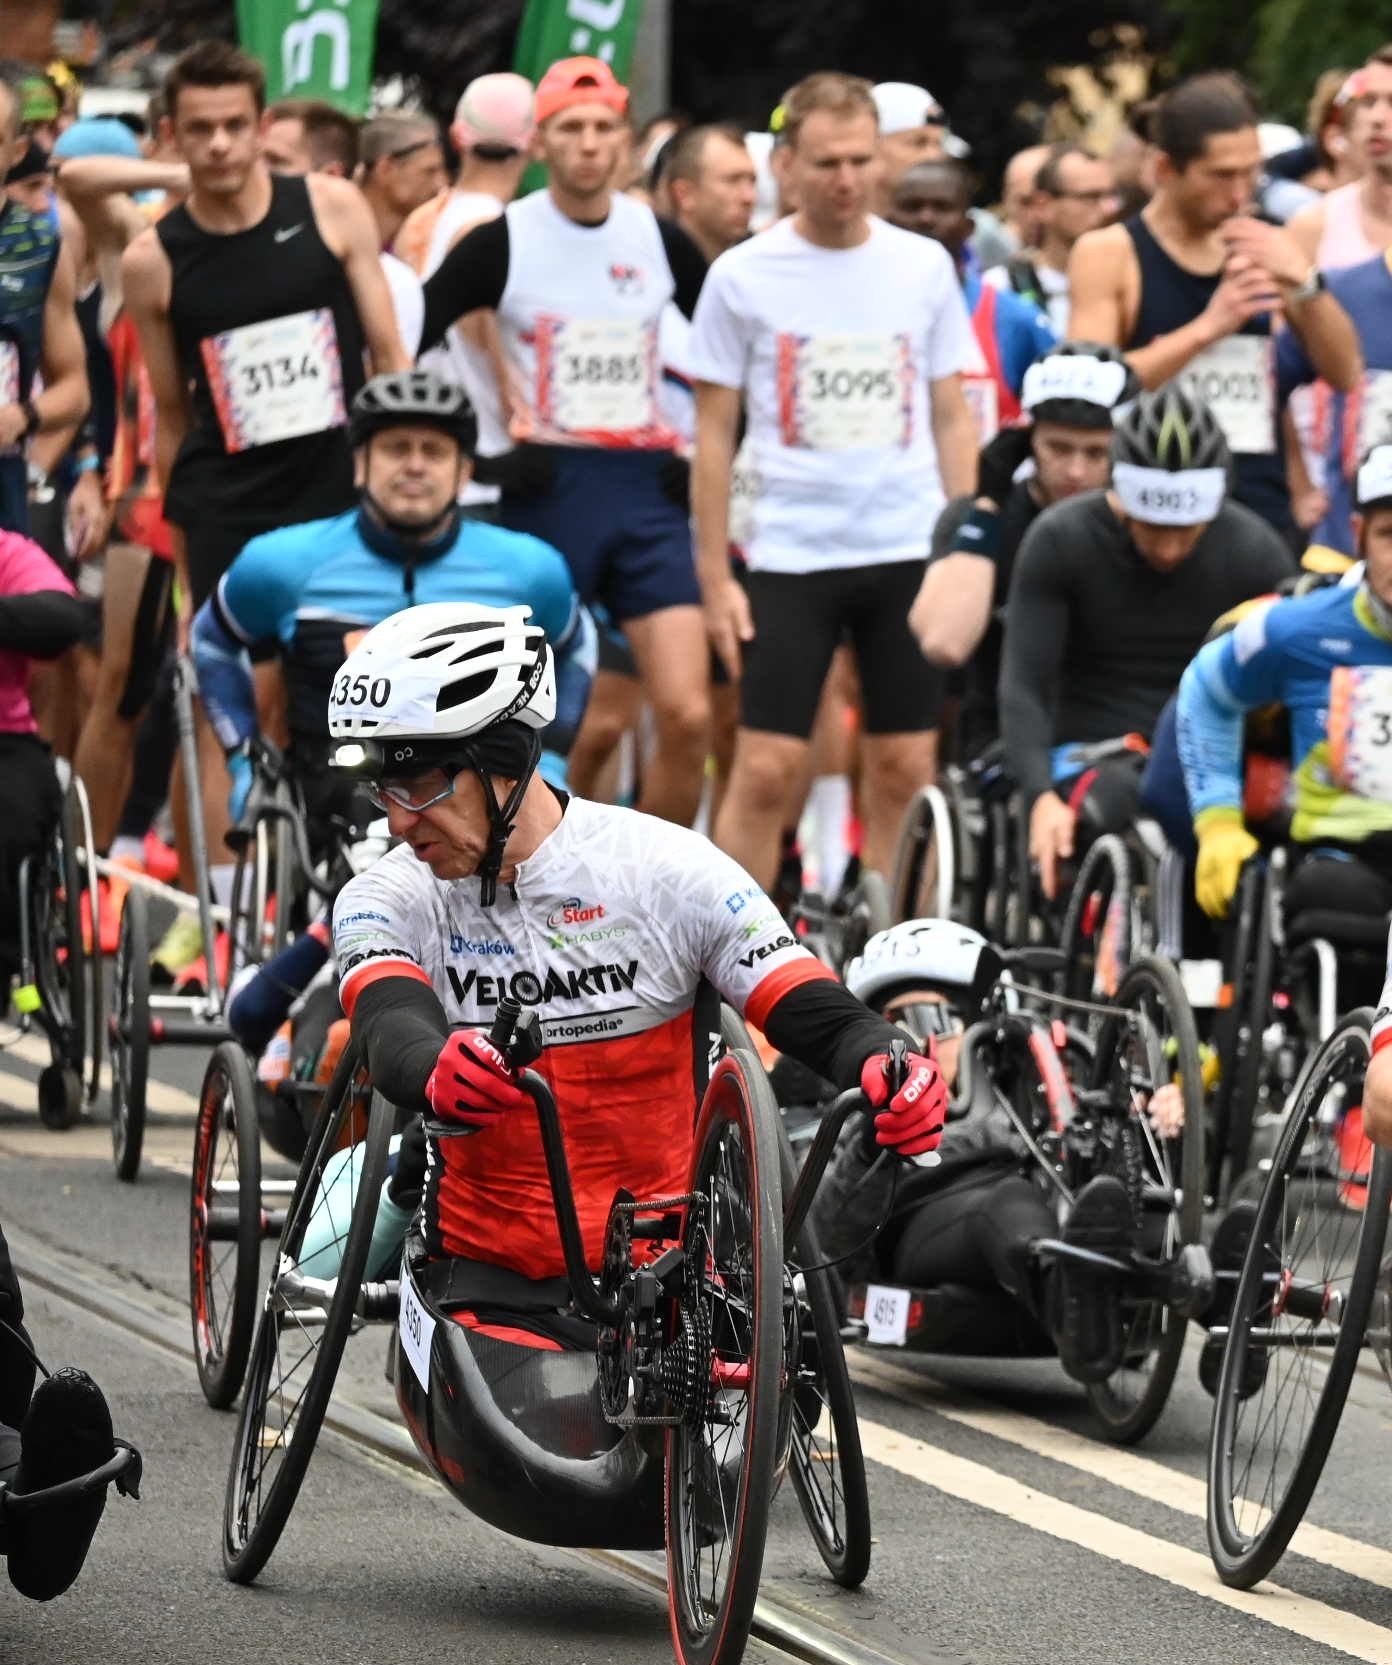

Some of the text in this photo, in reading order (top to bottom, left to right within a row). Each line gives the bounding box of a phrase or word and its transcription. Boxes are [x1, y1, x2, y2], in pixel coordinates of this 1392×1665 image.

[240, 352, 319, 397] 3134
[810, 369, 895, 401] 3095
[563, 903, 605, 924] Start
[462, 938, 516, 957] Kraków
